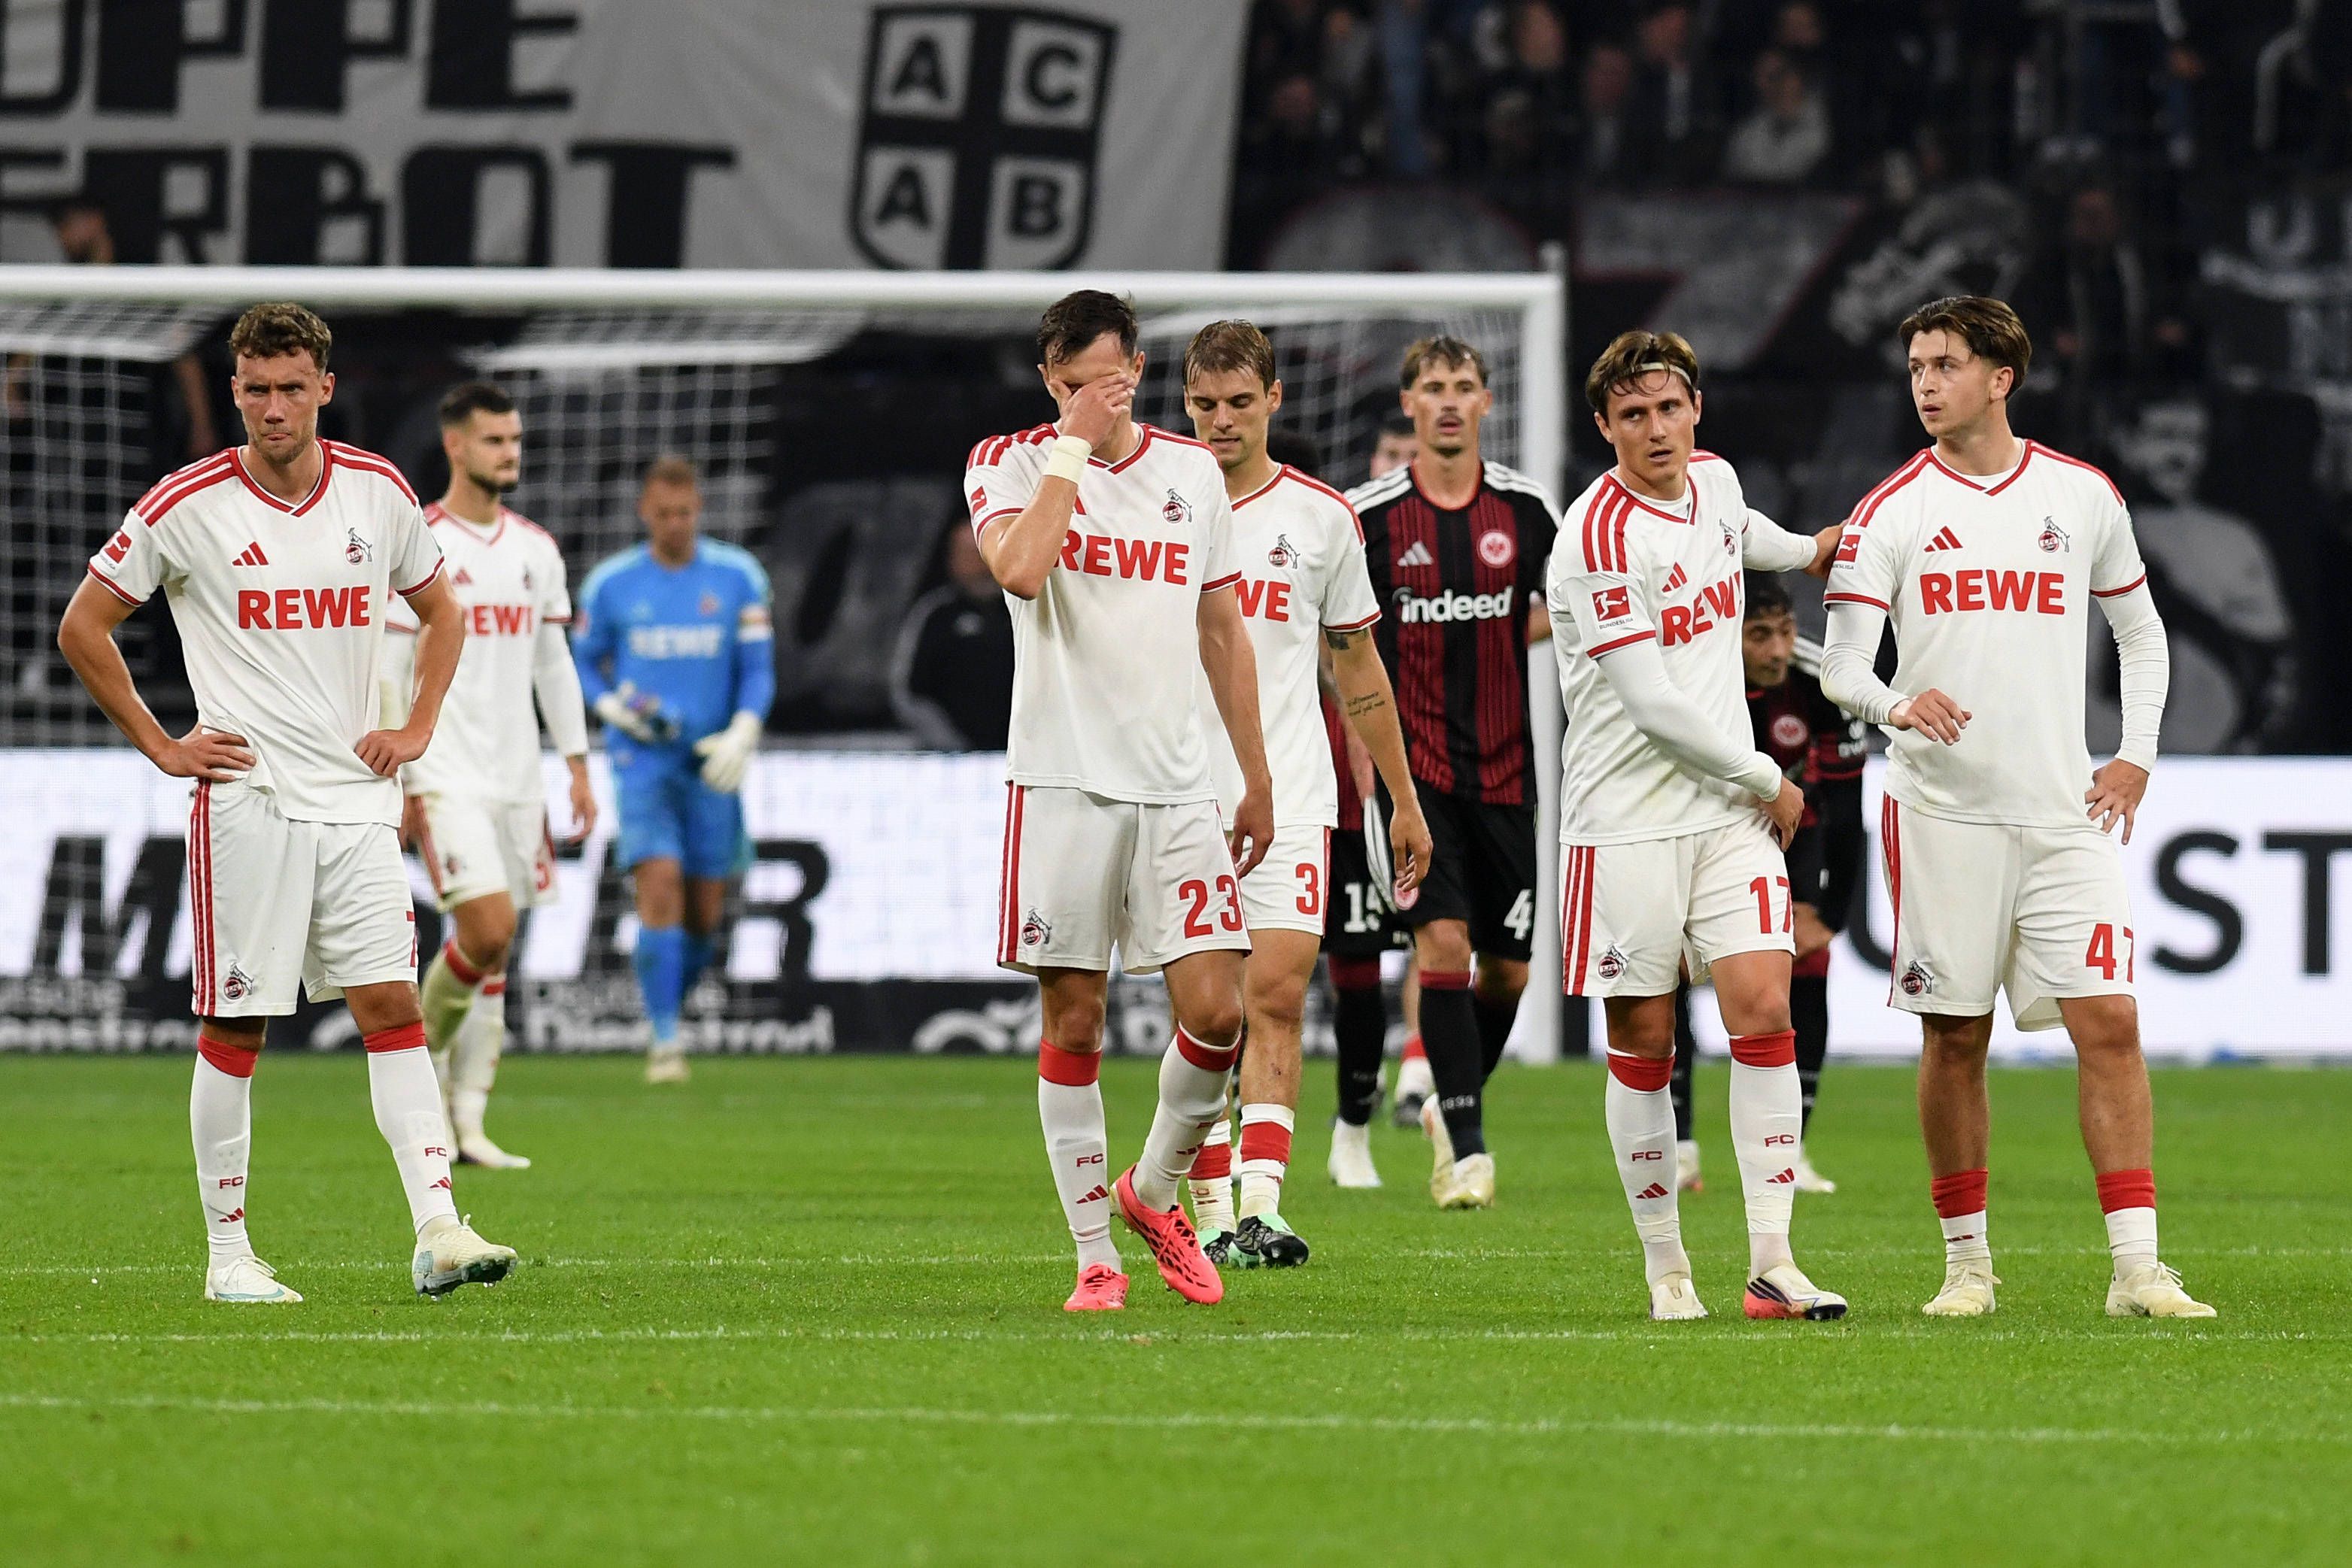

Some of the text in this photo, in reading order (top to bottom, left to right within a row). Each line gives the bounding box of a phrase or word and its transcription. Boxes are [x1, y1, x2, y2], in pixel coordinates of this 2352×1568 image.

[892, 34, 1077, 108] A C
[874, 162, 1061, 239] A B
[1053, 529, 1190, 586] REWE
[238, 585, 371, 631] REWE
[1234, 578, 1291, 623] WE
[1395, 584, 1514, 624] indeed
[1660, 569, 1741, 647] REW
[1919, 569, 2065, 616] REWE
[462, 604, 533, 636] EW
[1178, 874, 1243, 940] 23
[1295, 862, 1319, 916] 3
[1749, 875, 1793, 935] 17
[1503, 888, 1534, 942] 4
[2085, 923, 2134, 984] 47
[424, 1146, 448, 1158] FC
[1076, 1152, 1105, 1168] FC
[1631, 1150, 1663, 1163] FC
[1764, 1133, 1795, 1148] FC
[218, 1175, 244, 1190] FC
